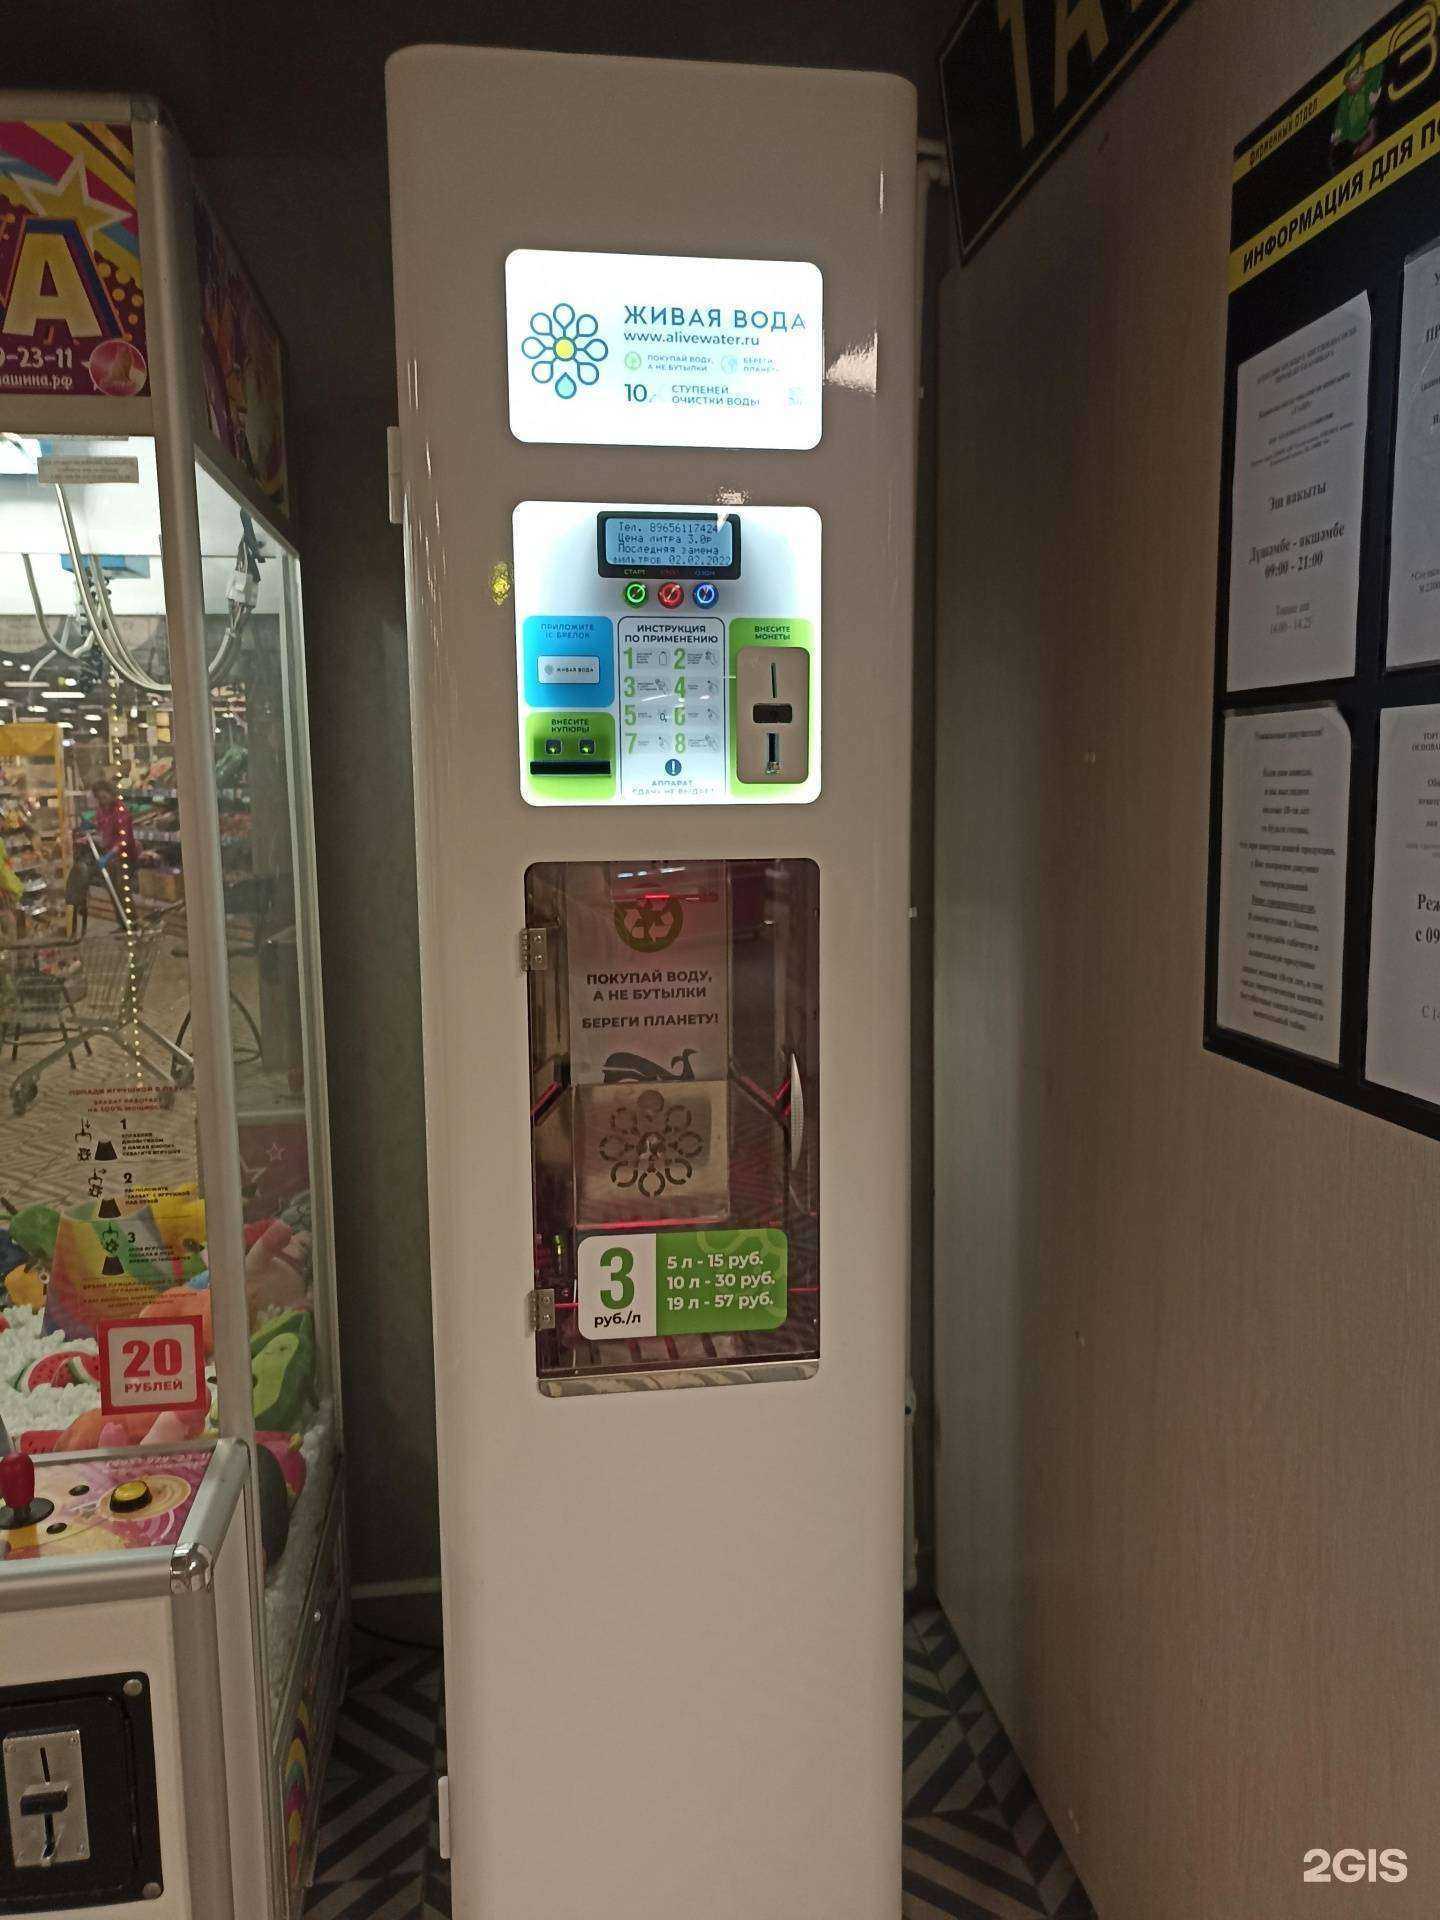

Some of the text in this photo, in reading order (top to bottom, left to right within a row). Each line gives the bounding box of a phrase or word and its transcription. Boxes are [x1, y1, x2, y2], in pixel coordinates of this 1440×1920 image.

[1242, 118, 1440, 273] ИНФОРМАЦИЯ ДЛЯ П
[624, 305, 807, 333] ЖИВАЯ ВОДА
[623, 330, 760, 346] www.alivewater.ru
[647, 354, 687, 364] ПОКУПАЙ
[623, 384, 648, 403] 10
[672, 384, 729, 394] СТУПЕНЕЙ
[672, 396, 760, 407] ОЧИСТКИ ВОДЫ
[618, 522, 642, 532] Тел.
[618, 534, 644, 545] Цена
[650, 535, 682, 545] литра
[618, 543, 676, 555] Последняя
[540, 623, 595, 632] ПРИЛОЖИТЕ
[637, 624, 706, 635] ИНСТРУКЦИЯ
[754, 625, 791, 633] ВНЕСИТЕ
[624, 634, 719, 644] ПО ПРИМЕНЕНИЮ
[754, 633, 791, 641] МОНЕТЫ
[624, 647, 633, 669] 1
[674, 648, 686, 670] 2
[624, 676, 636, 698] 3
[674, 676, 686, 699] 4
[552, 718, 589, 727] ВНЕСИТЕ
[624, 704, 637, 726] 5
[552, 726, 591, 734] КУПЮРЫ
[625, 733, 638, 754] 7
[674, 733, 686, 754] 8
[586, 969, 713, 985] ПОКУПАЙ ВОДУ,
[593, 987, 707, 1002] А НЕ БУТЫЛКИ
[582, 1013, 719, 1029] БЕРЕГИ ПЛАНЕТУ!
[120, 1118, 127, 1131] 1
[124, 1172, 133, 1184] 2
[128, 1232, 136, 1243] 3
[667, 1256, 677, 1269] 5
[681, 1257, 692, 1268] л
[707, 1254, 724, 1267] 15
[728, 1252, 764, 1270] руб.
[600, 1247, 635, 1310] 3
[667, 1276, 685, 1290] 10
[688, 1278, 700, 1288] л
[715, 1274, 736, 1287] 30
[740, 1271, 776, 1290] руб.
[667, 1297, 684, 1311] 19
[688, 1298, 699, 1308] л
[714, 1294, 732, 1307] 57
[738, 1291, 774, 1310] руб.
[594, 1310, 641, 1328] руб./л
[122, 1338, 182, 1378] 20
[124, 1379, 183, 1394] РУБЛЕЙ
